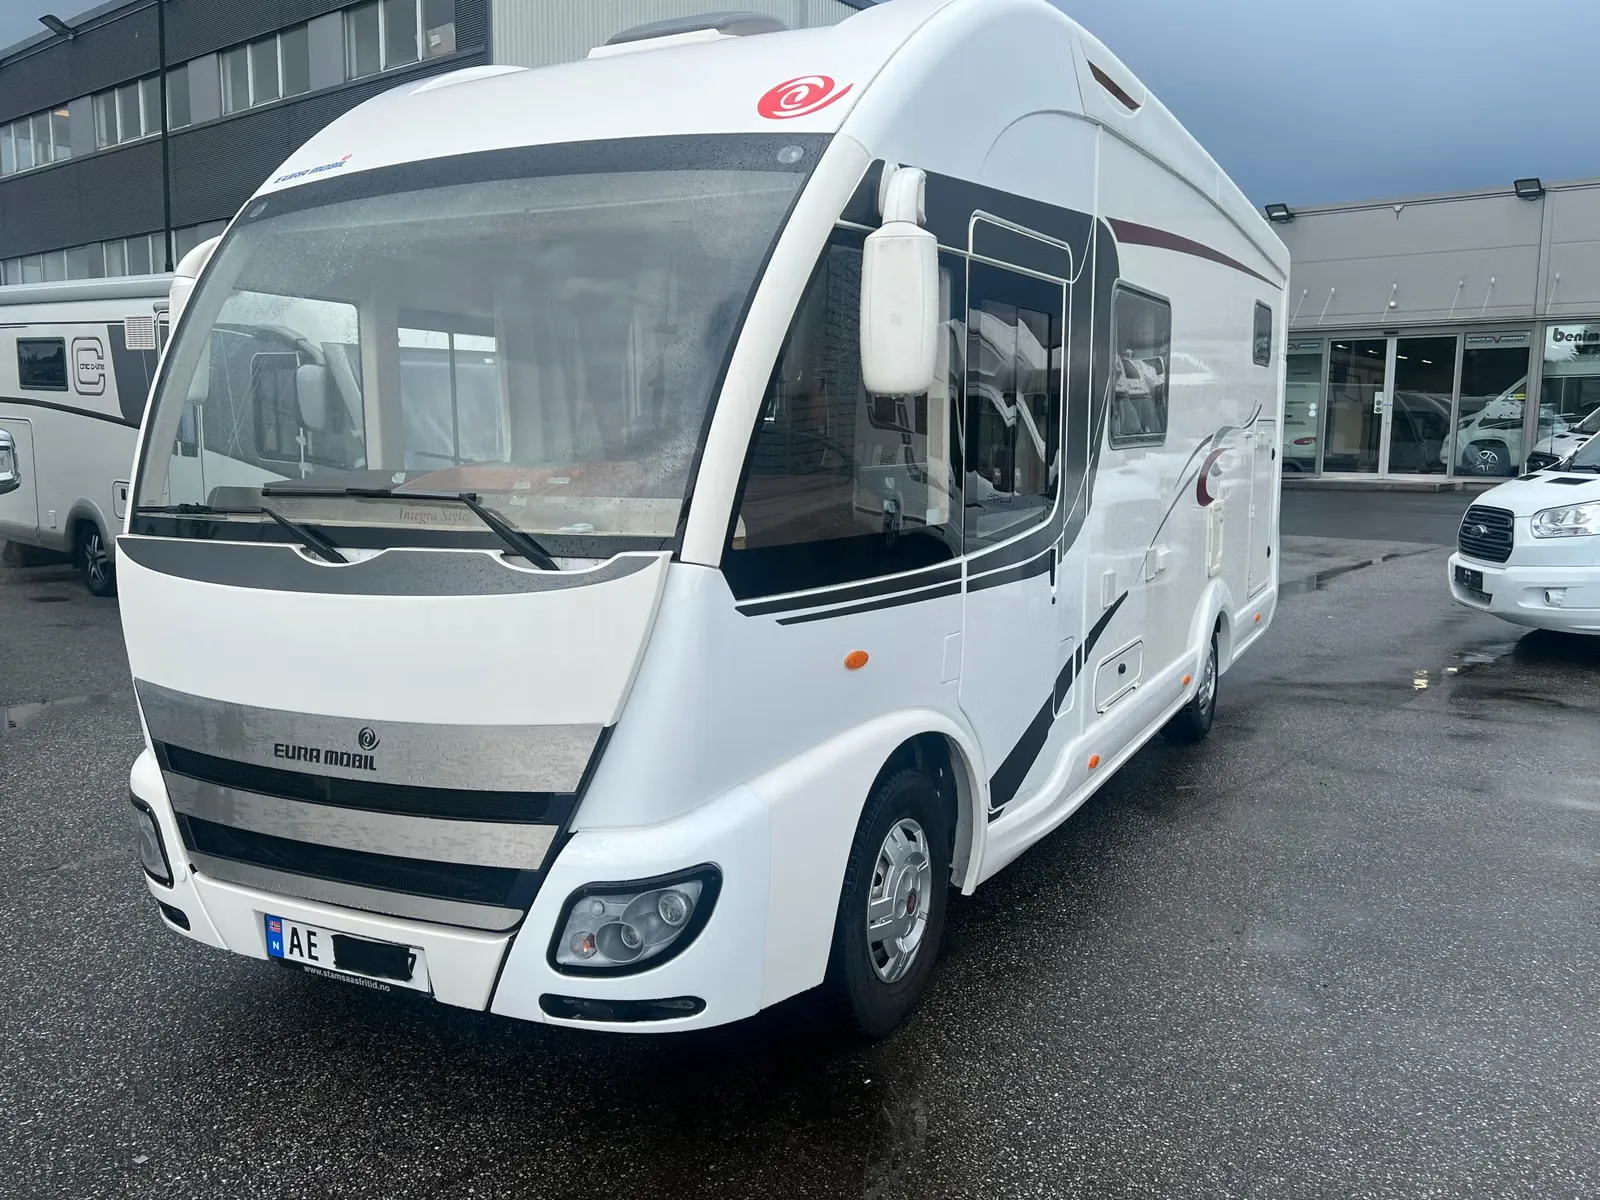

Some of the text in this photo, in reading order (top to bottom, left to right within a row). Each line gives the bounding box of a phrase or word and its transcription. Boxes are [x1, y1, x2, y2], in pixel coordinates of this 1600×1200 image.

[400, 507, 469, 526] Integra Style
[273, 742, 377, 771] EURA MOBIL
[272, 940, 280, 951] N
[288, 926, 319, 961] AE
[303, 965, 391, 992] www.stamsaasfritid.no
